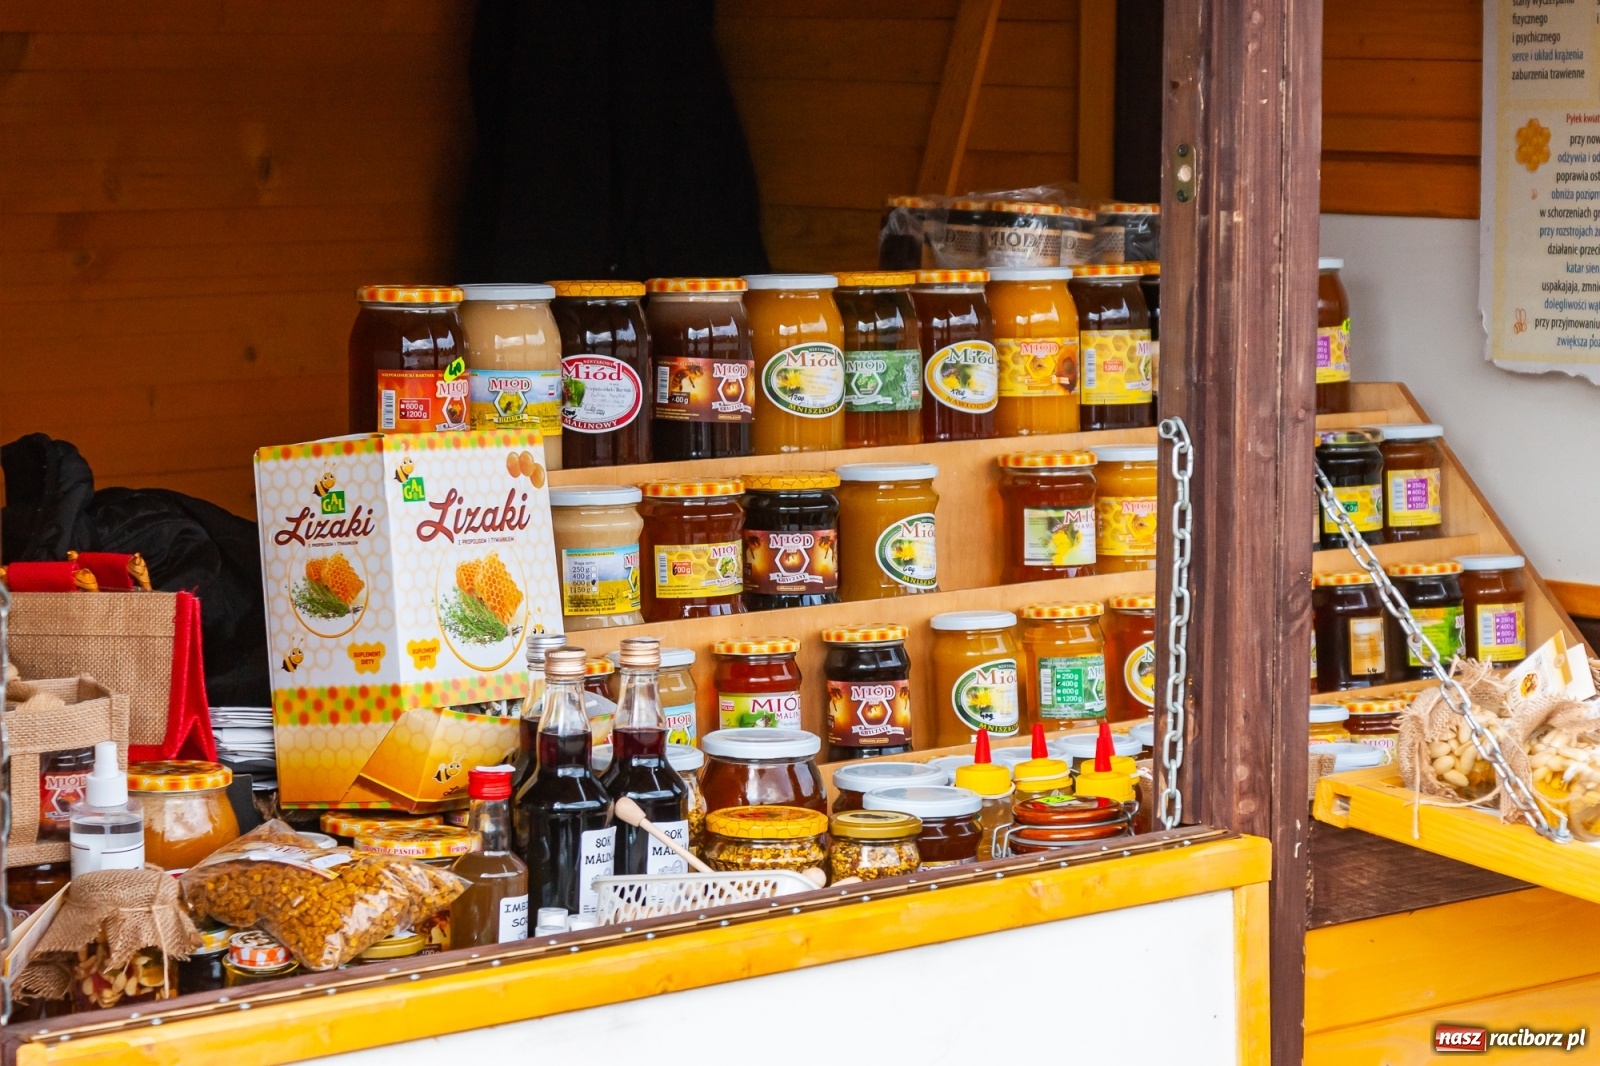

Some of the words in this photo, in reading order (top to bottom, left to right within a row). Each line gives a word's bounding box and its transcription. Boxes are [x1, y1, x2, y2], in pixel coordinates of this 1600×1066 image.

[1512, 13, 1548, 27] fizycznego
[1512, 33, 1515, 43] i
[1516, 31, 1561, 44] psychicznego
[1512, 52, 1529, 62] serce
[1530, 51, 1533, 60] i
[1534, 50, 1553, 61] układ
[1555, 49, 1584, 63] krążenia
[1512, 69, 1548, 80] zaburzenia
[1550, 68, 1585, 79] trawienne
[1570, 135, 1585, 147] przy
[1558, 151, 1587, 165] odżywia
[1588, 152, 1591, 162] i
[1556, 170, 1588, 184] poprawia
[1552, 188, 1574, 200] obniża
[1540, 209, 1546, 218] w
[1547, 206, 1592, 218] schorzeniach
[1540, 226, 1554, 239] przy
[1556, 225, 1593, 239] rozstrojach
[1547, 243, 1578, 255] działanie
[1566, 261, 1584, 273] katar
[1544, 298, 1587, 312] dolegliwości
[1535, 317, 1550, 330] przy
[1557, 335, 1587, 349] zwiększa
[784, 349, 838, 367] Miód
[948, 347, 994, 365] Miód
[562, 362, 623, 380] Miód
[563, 417, 617, 429] MALINOWY
[416, 488, 531, 544] Lizaki
[274, 504, 375, 546] Lizaki
[899, 522, 936, 538] Mió
[771, 535, 813, 547] MIÓD
[570, 586, 585, 594] 1150
[853, 686, 894, 699] MIÓD
[775, 712, 800, 720] MALIN
[664, 828, 683, 840] SOK
[595, 836, 612, 848] SOK
